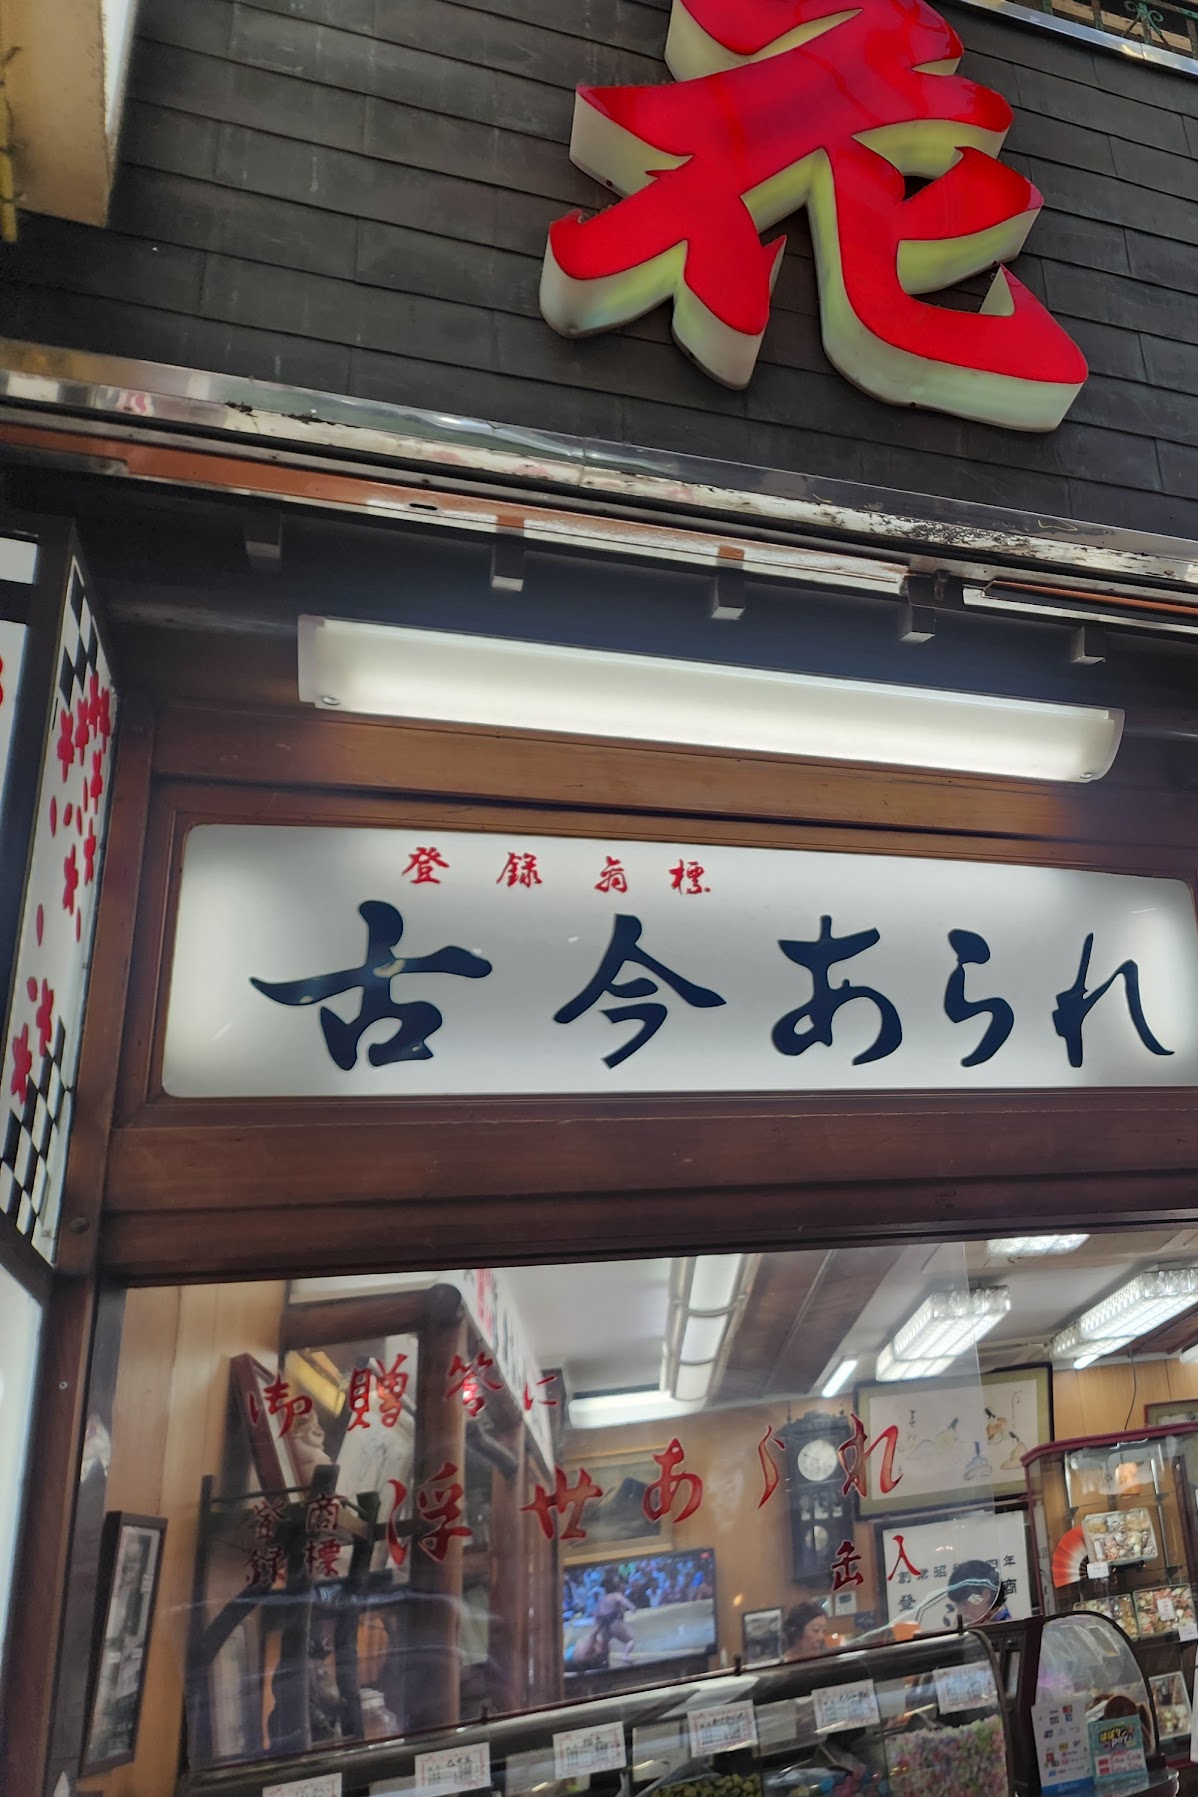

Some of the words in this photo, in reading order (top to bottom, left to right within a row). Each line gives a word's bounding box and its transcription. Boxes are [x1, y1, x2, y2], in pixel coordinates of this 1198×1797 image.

[250, 899, 1176, 1071] 古今あられ
[387, 1412, 903, 1566] 浮世あられ
[831, 1534, 922, 1591] 缶入
